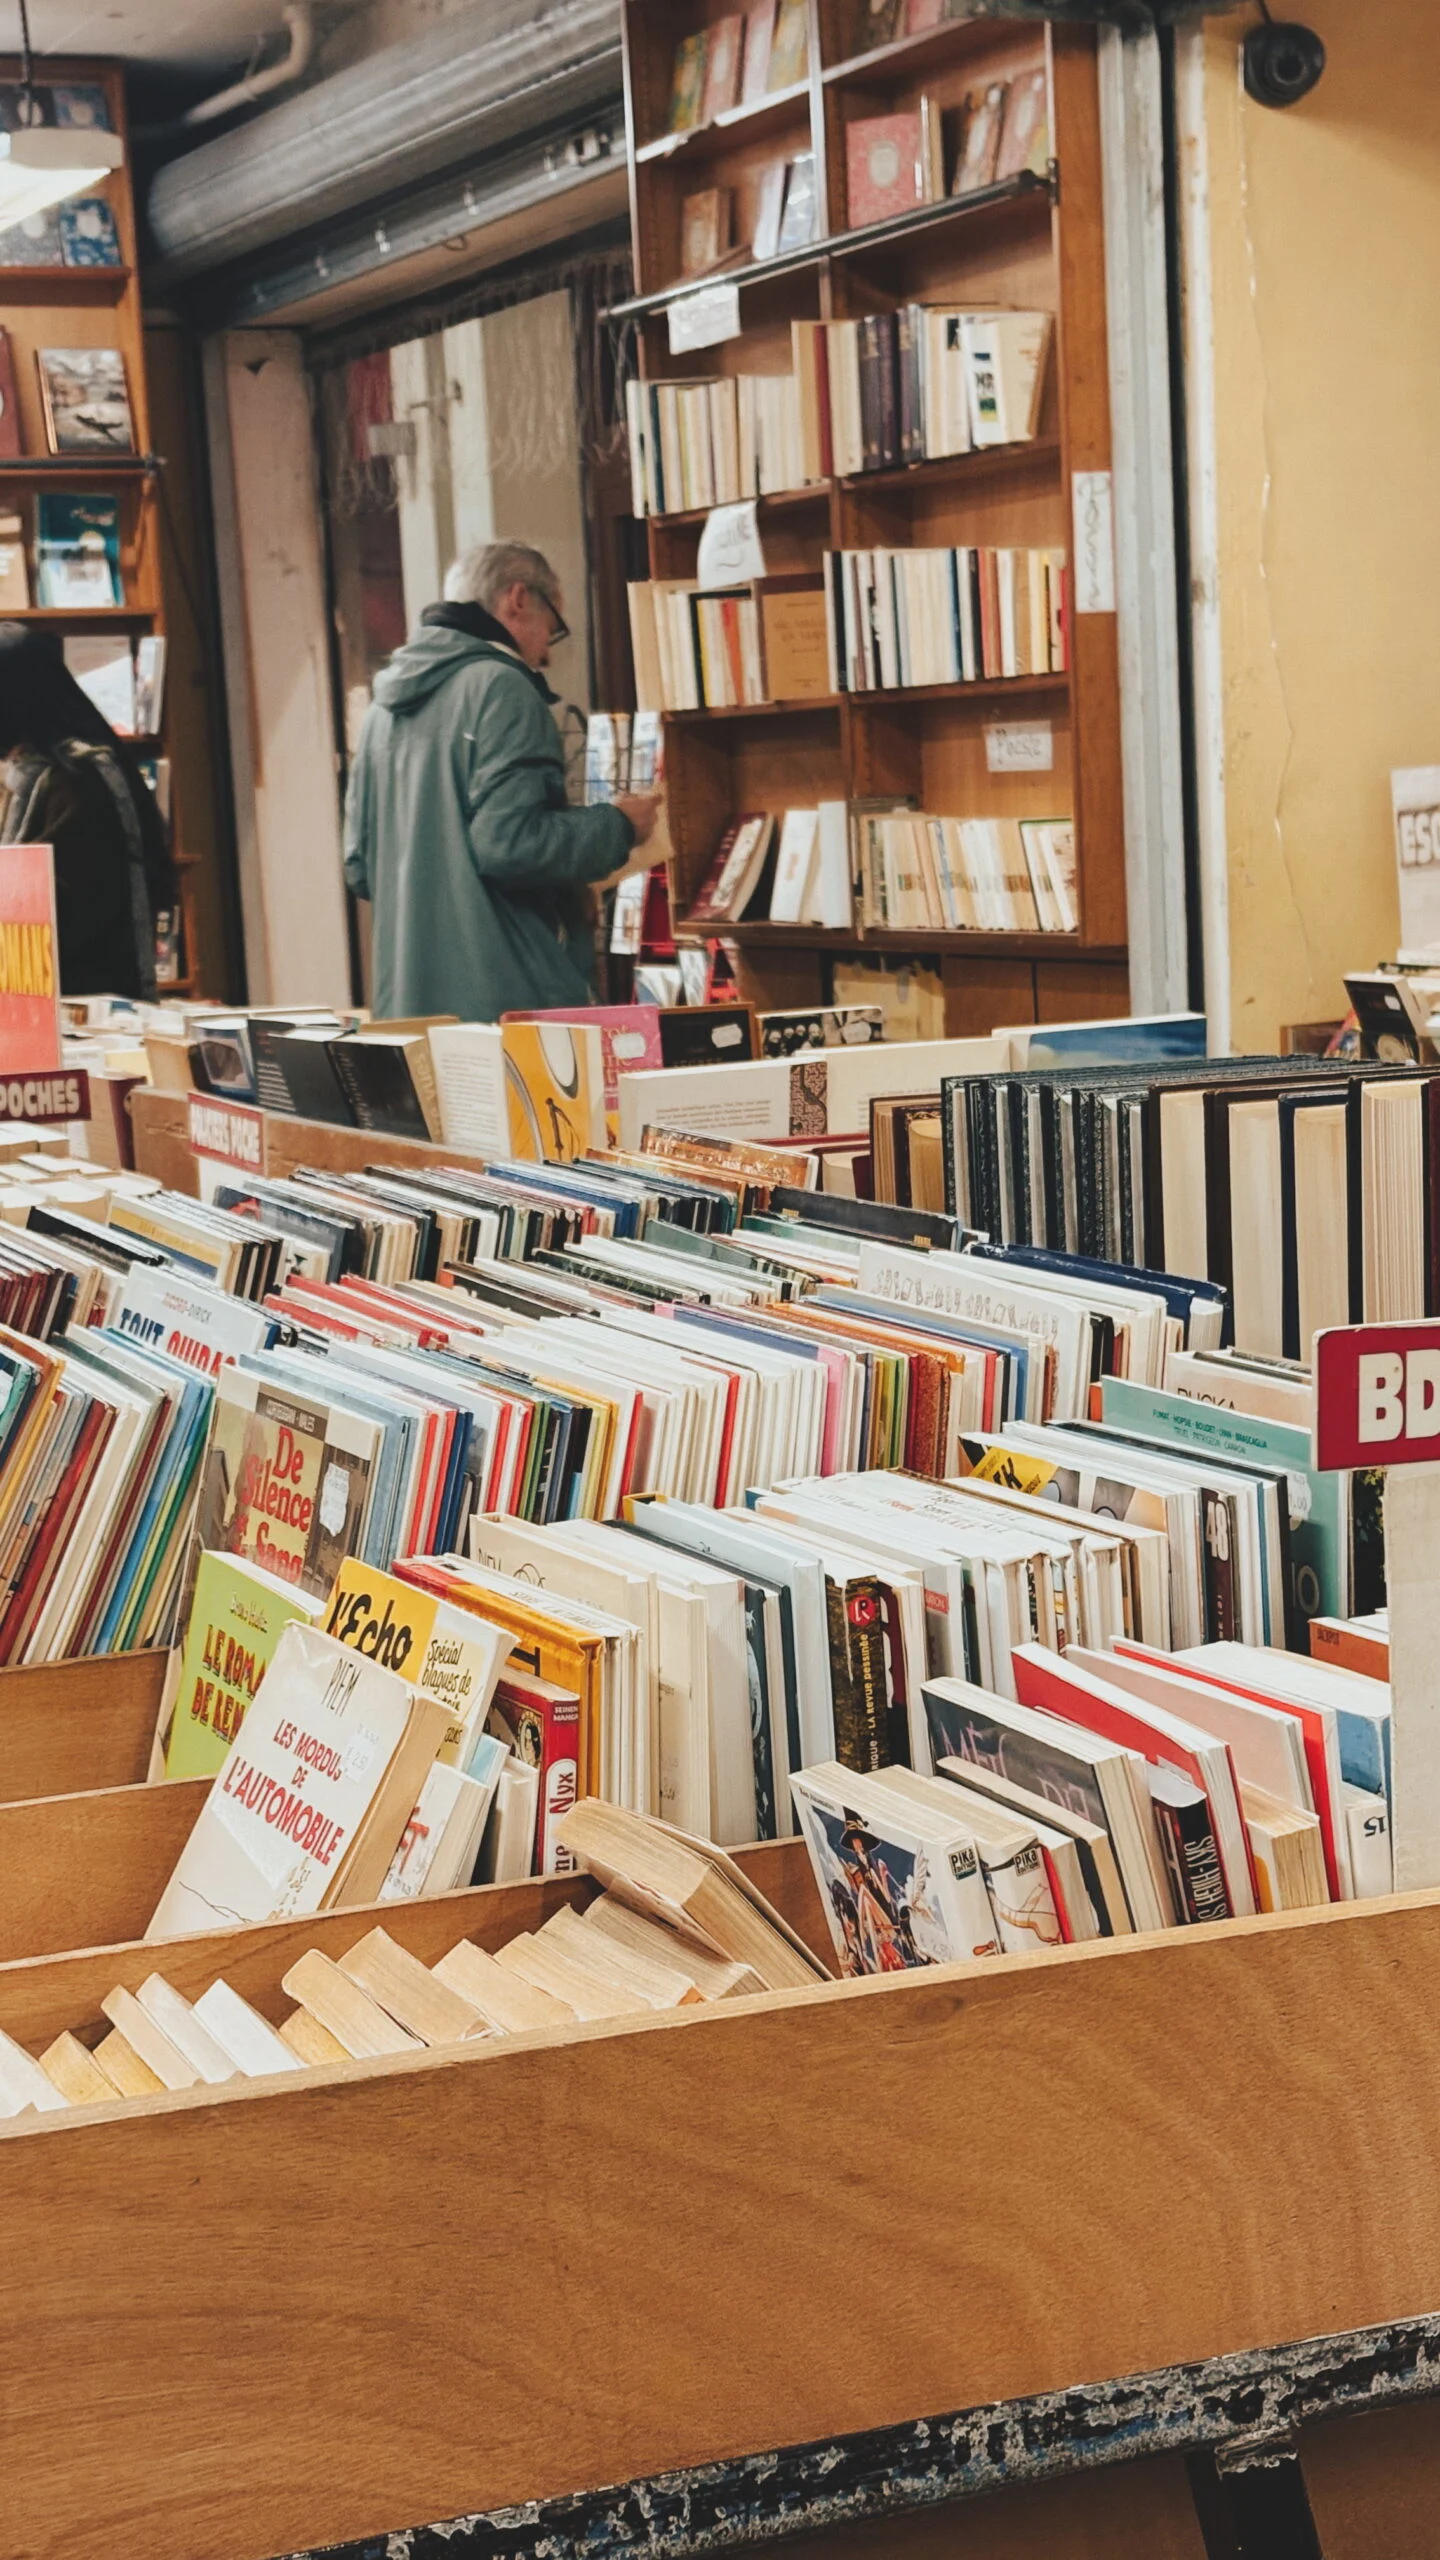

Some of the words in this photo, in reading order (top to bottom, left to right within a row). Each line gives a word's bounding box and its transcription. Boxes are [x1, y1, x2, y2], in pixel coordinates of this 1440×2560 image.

[1357, 1348, 1440, 1444] BD
[272, 1425, 304, 1485] De
[242, 1454, 313, 1533] Silence
[1203, 1499, 1229, 1562] 48
[202, 1623, 227, 1679] LE
[427, 1638, 465, 1668] Spécial
[190, 1676, 216, 1729] DE
[320, 1656, 363, 1719] PIEM
[421, 1661, 460, 1695] blagues
[458, 1668, 473, 1696] de
[553, 1713, 579, 1722] MANGA
[554, 1705, 579, 1714] SEINEN
[868, 1715, 876, 1730] LA
[272, 1718, 298, 1751] LES
[293, 1731, 343, 1783] MORDUS
[290, 1765, 309, 1790] DE
[222, 1755, 345, 1867] L'AUTOMOBILE
[549, 1771, 575, 1814] Nyx
[1363, 1815, 1386, 1838] 15
[1184, 1834, 1225, 1903] SKY-HIGH
